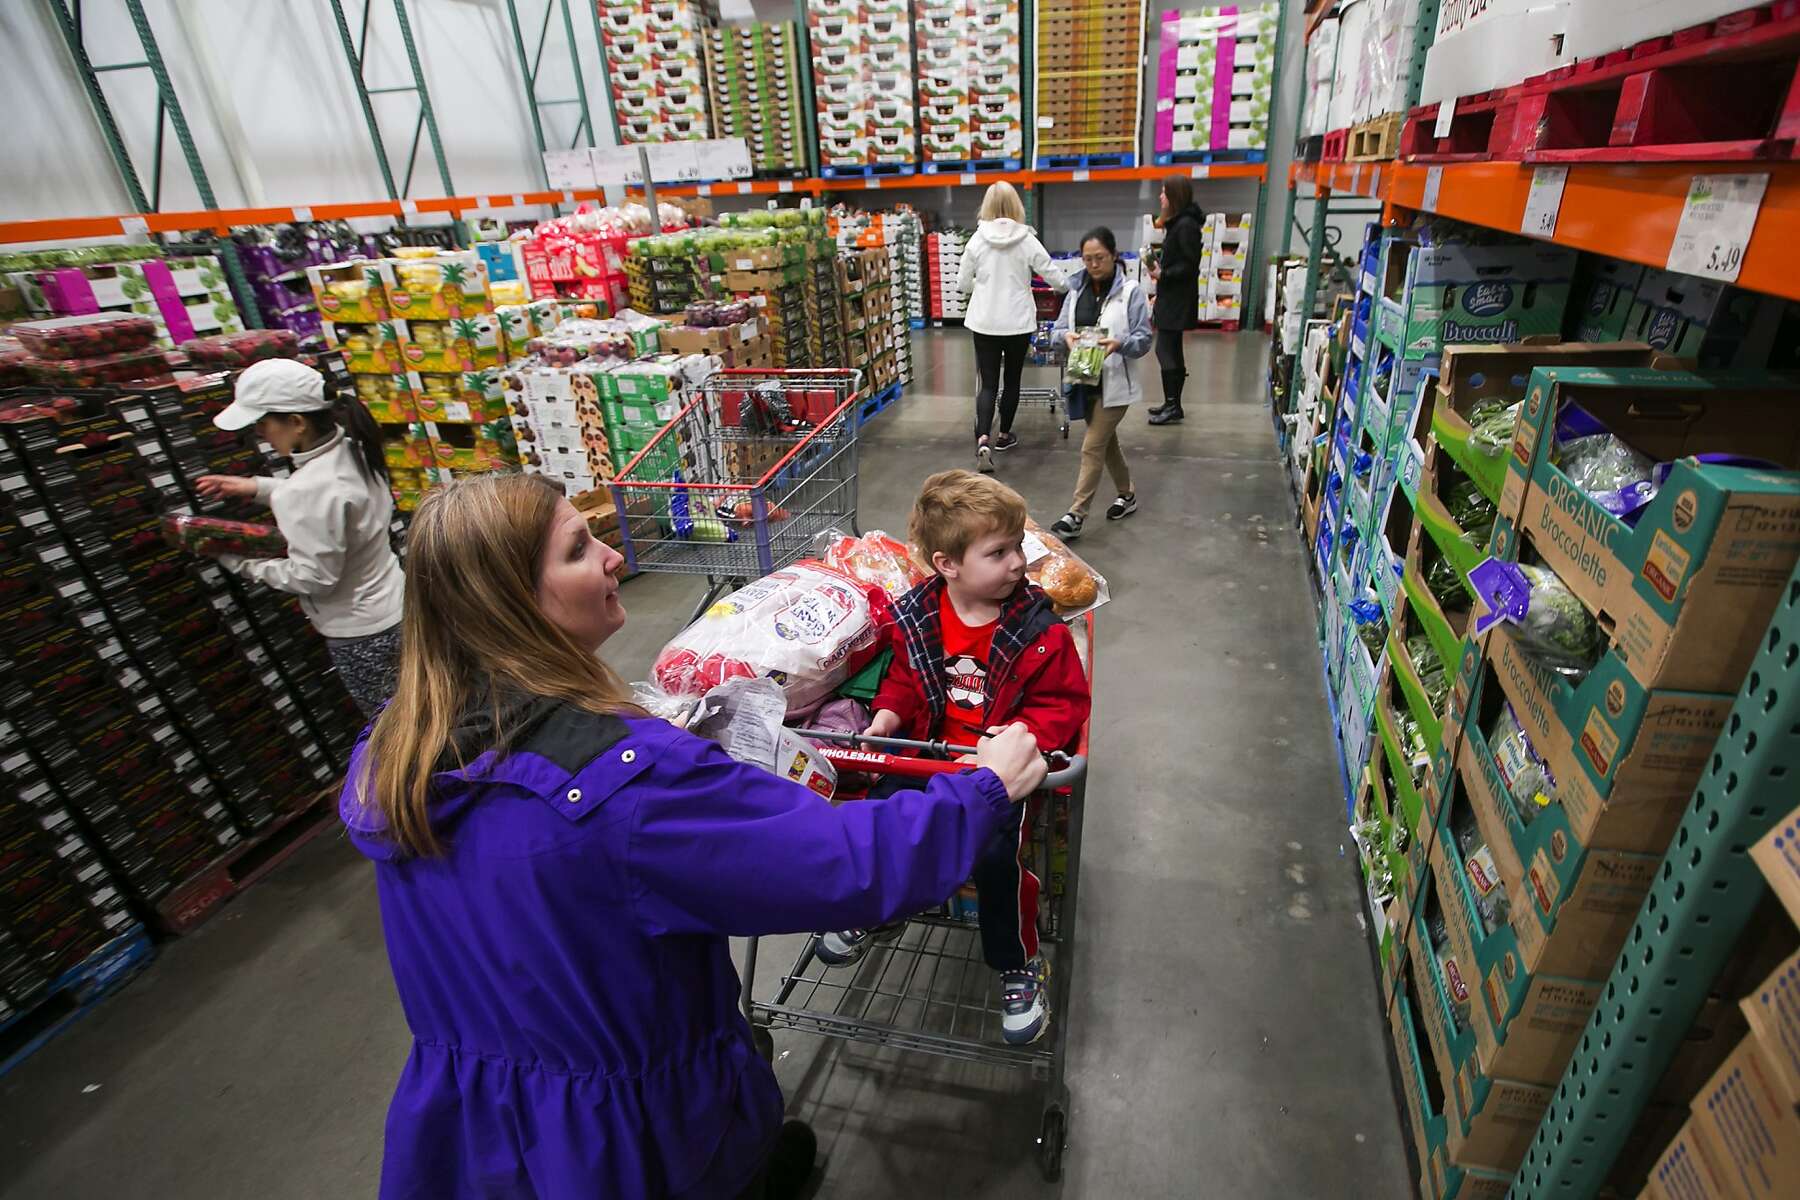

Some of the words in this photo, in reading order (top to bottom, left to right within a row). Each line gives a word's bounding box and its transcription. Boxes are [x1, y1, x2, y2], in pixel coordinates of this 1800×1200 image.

[1706, 245, 1741, 272] 5.49
[1469, 293, 1504, 309] Smart
[1477, 284, 1497, 297] Eat
[1442, 320, 1518, 343] Broccoli
[1548, 474, 1620, 549] ORGANIC
[1540, 502, 1607, 588] Broccolette
[1503, 642, 1550, 738] Broccolette
[818, 748, 886, 763] WHOLESALE
[1474, 740, 1517, 831] ORGANIC
